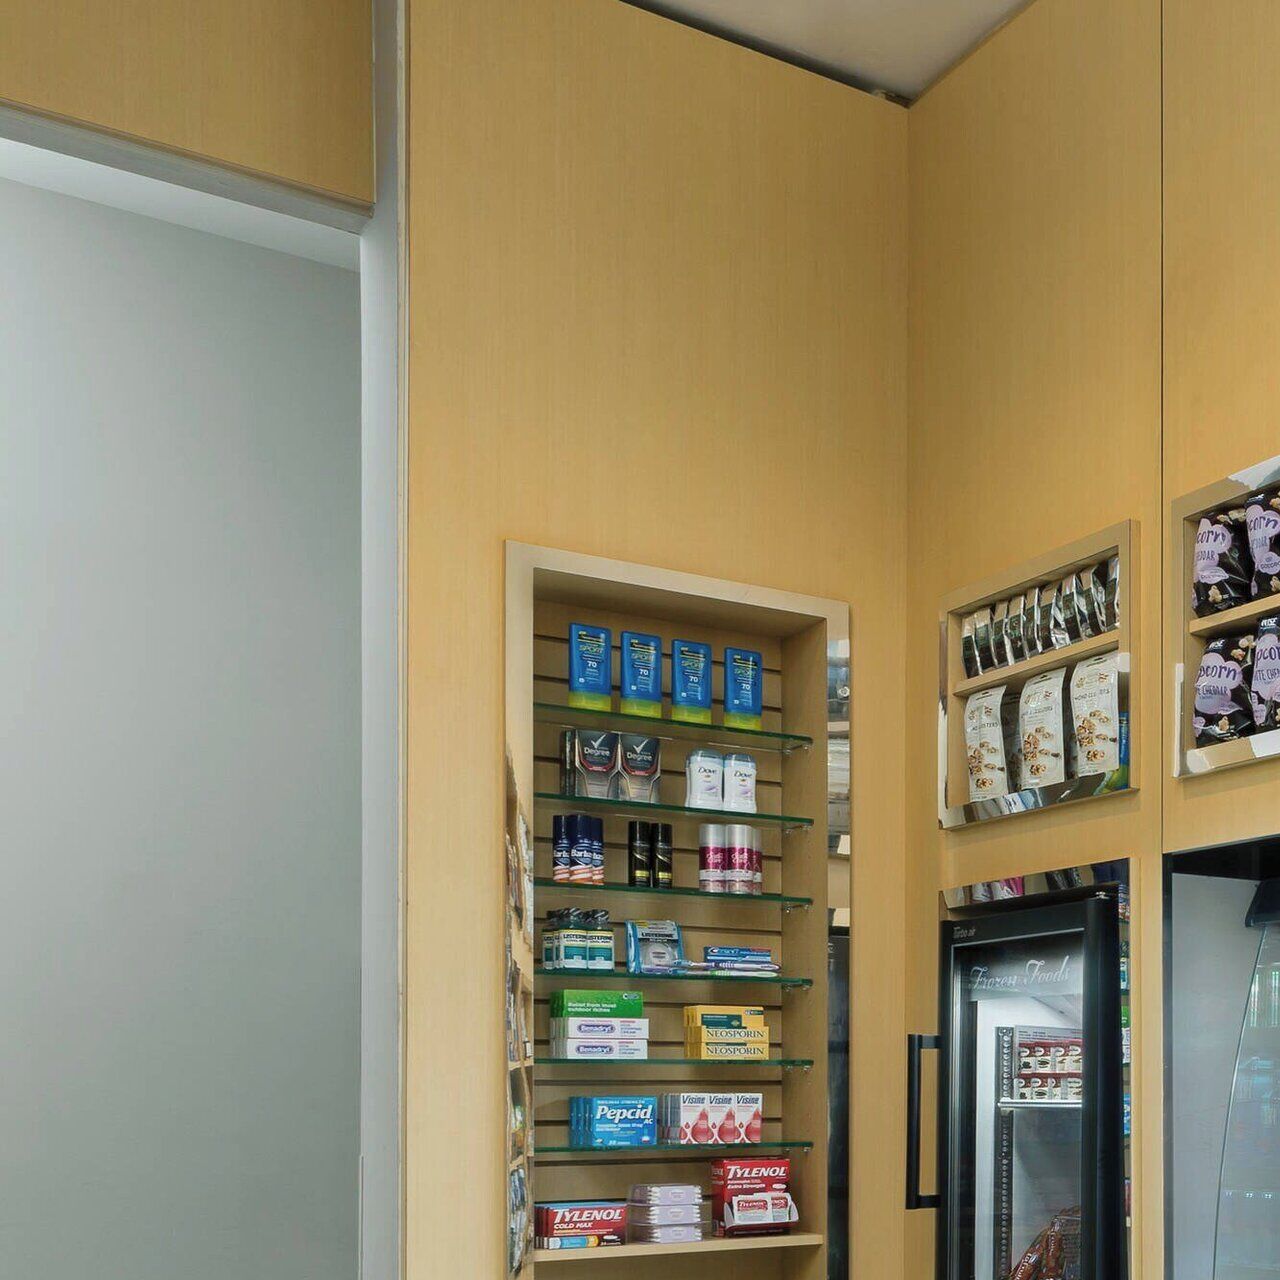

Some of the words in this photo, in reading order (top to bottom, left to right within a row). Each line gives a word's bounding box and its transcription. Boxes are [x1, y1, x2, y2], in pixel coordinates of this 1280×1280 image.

[584, 747, 610, 757] Degree
[626, 751, 652, 761] Degree
[734, 770, 752, 778] Dove
[706, 1029, 764, 1037] NEOSPORIN
[706, 1046, 764, 1055] NEOSPORIN
[682, 1095, 706, 1104] Visine
[709, 1095, 732, 1104] Visine
[736, 1095, 759, 1104] Visine
[595, 1105, 653, 1123] Pepcid
[727, 1166, 787, 1178] TYLENOL
[554, 1208, 624, 1224] TYLENOL
